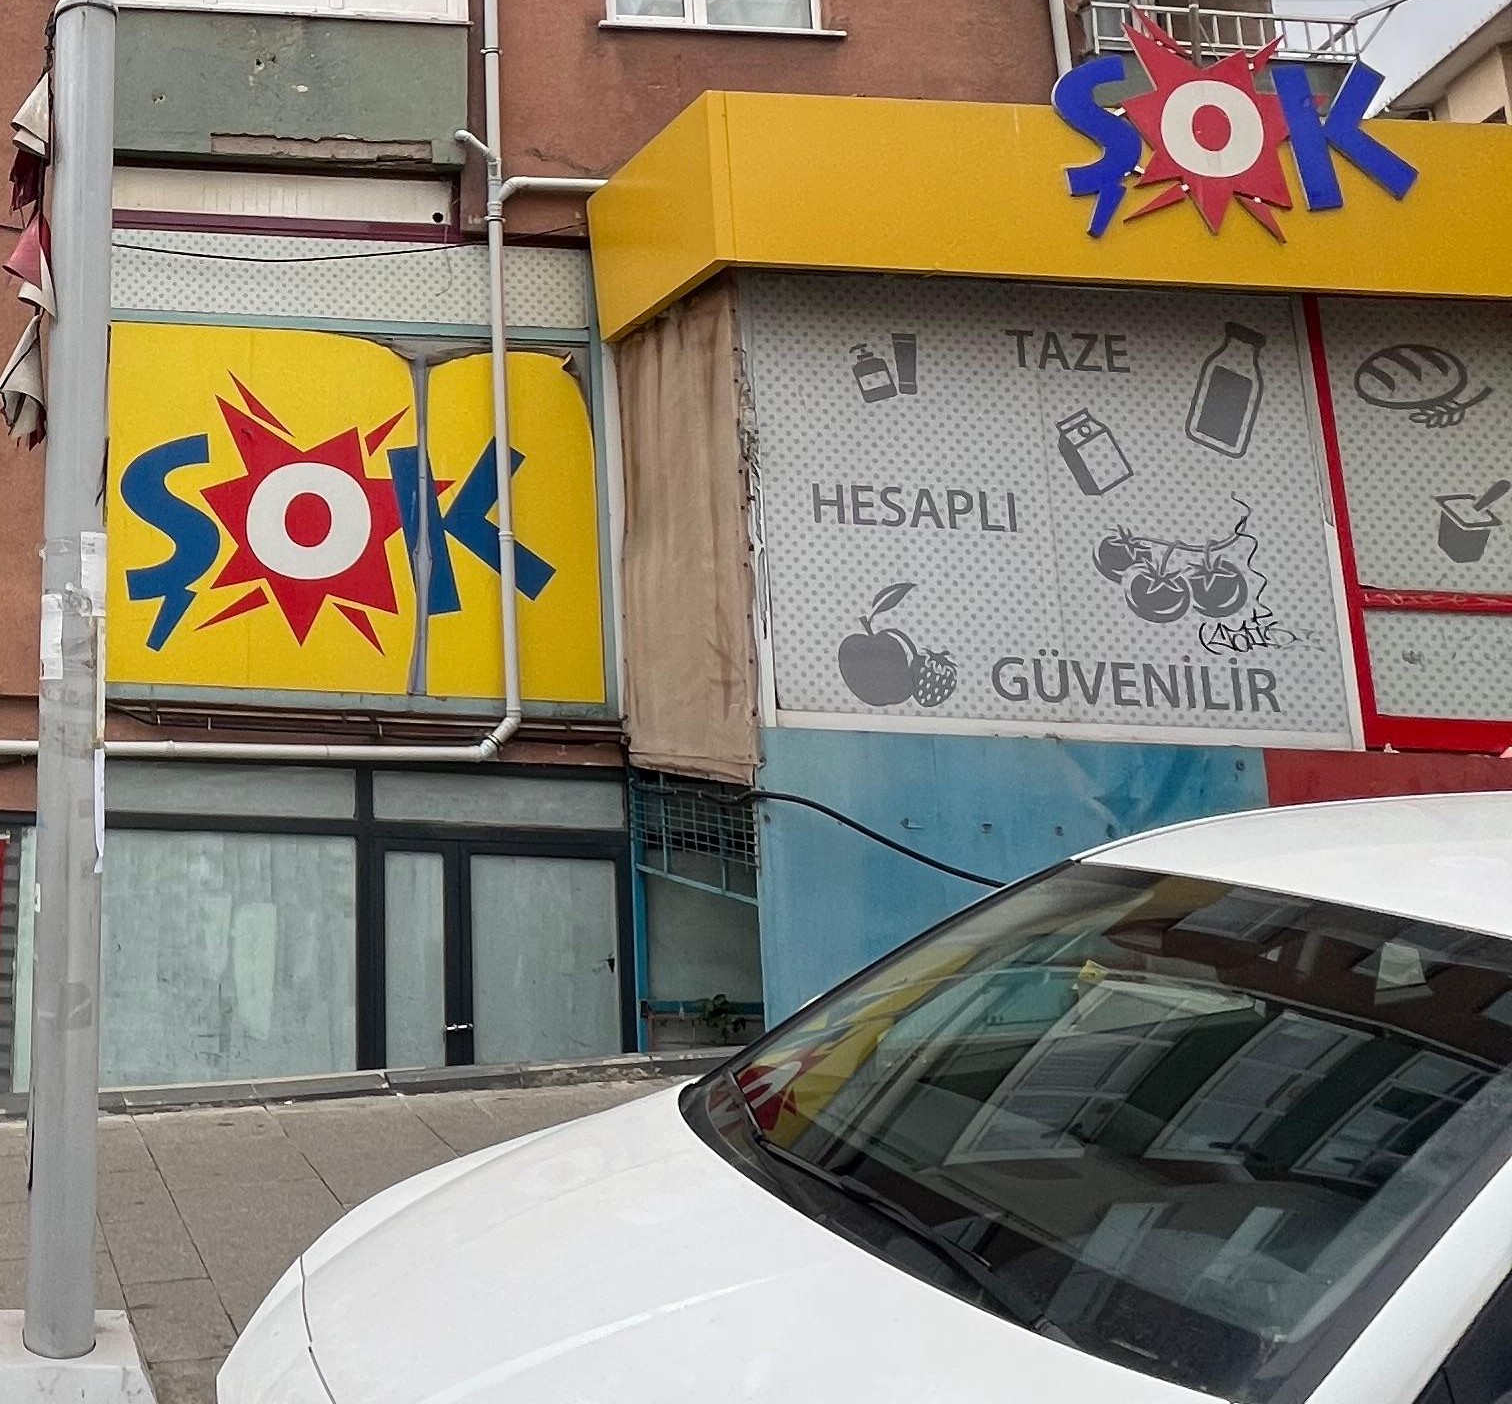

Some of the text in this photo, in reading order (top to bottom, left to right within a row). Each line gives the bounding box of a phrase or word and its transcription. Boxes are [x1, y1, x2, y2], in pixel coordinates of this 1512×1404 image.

[1051, 54, 1419, 239] ŞOK
[1005, 328, 1131, 374] TAZE
[811, 482, 1019, 532] HESAPLI
[120, 433, 556, 652] ŞOK
[990, 648, 1283, 714] GÜVENİLİR
